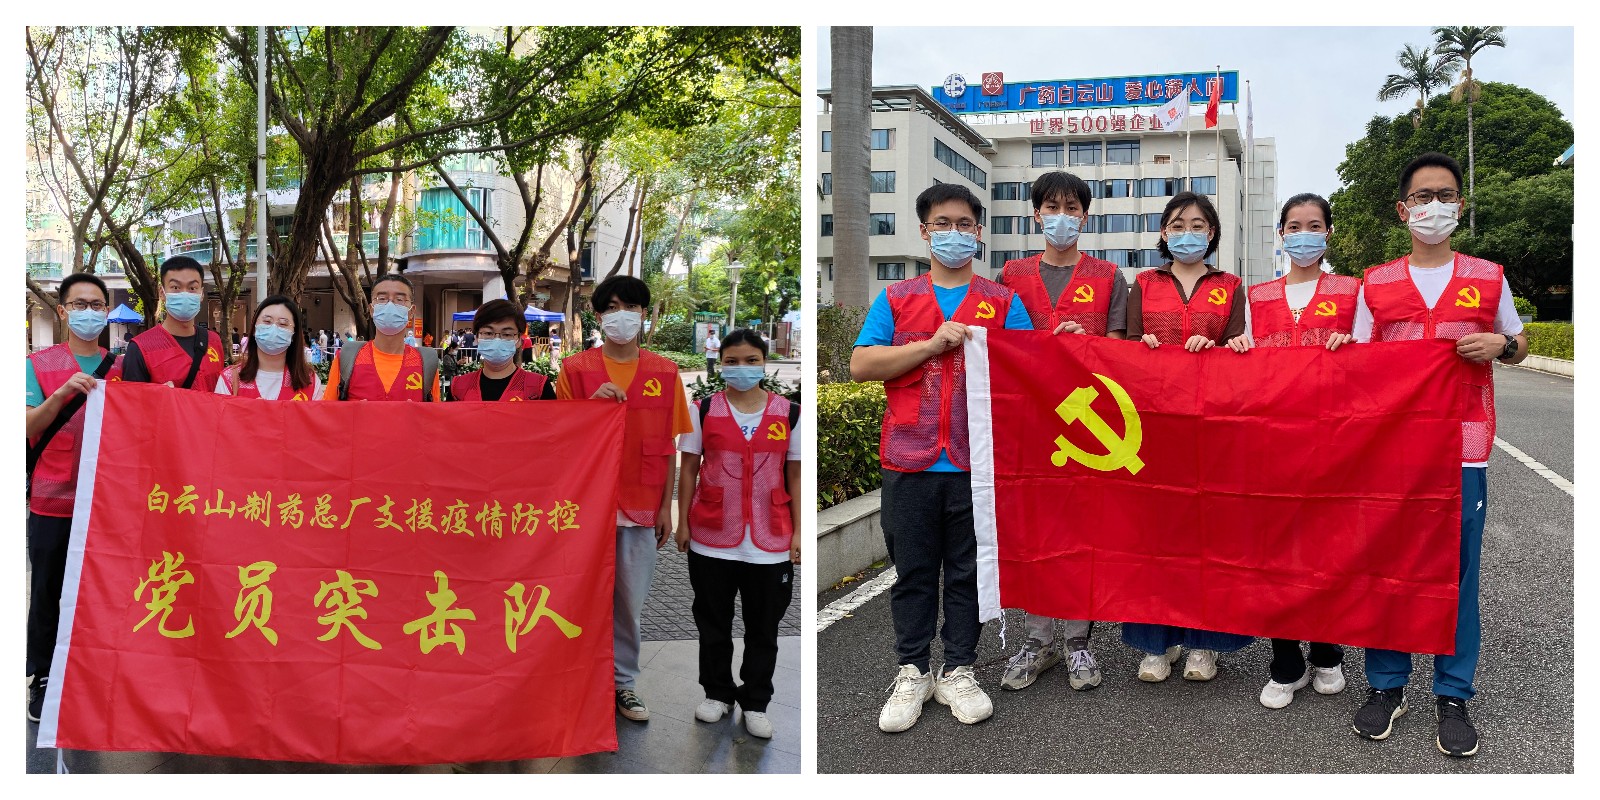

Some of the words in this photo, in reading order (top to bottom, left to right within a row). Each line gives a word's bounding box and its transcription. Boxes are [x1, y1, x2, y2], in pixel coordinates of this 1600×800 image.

[1018, 82, 1114, 106] 广药白云山
[1030, 114, 1164, 135] 世界500强企业
[146, 483, 582, 539] 白云山制药总厂支援疫情防控
[132, 550, 583, 656] 党员突击队
